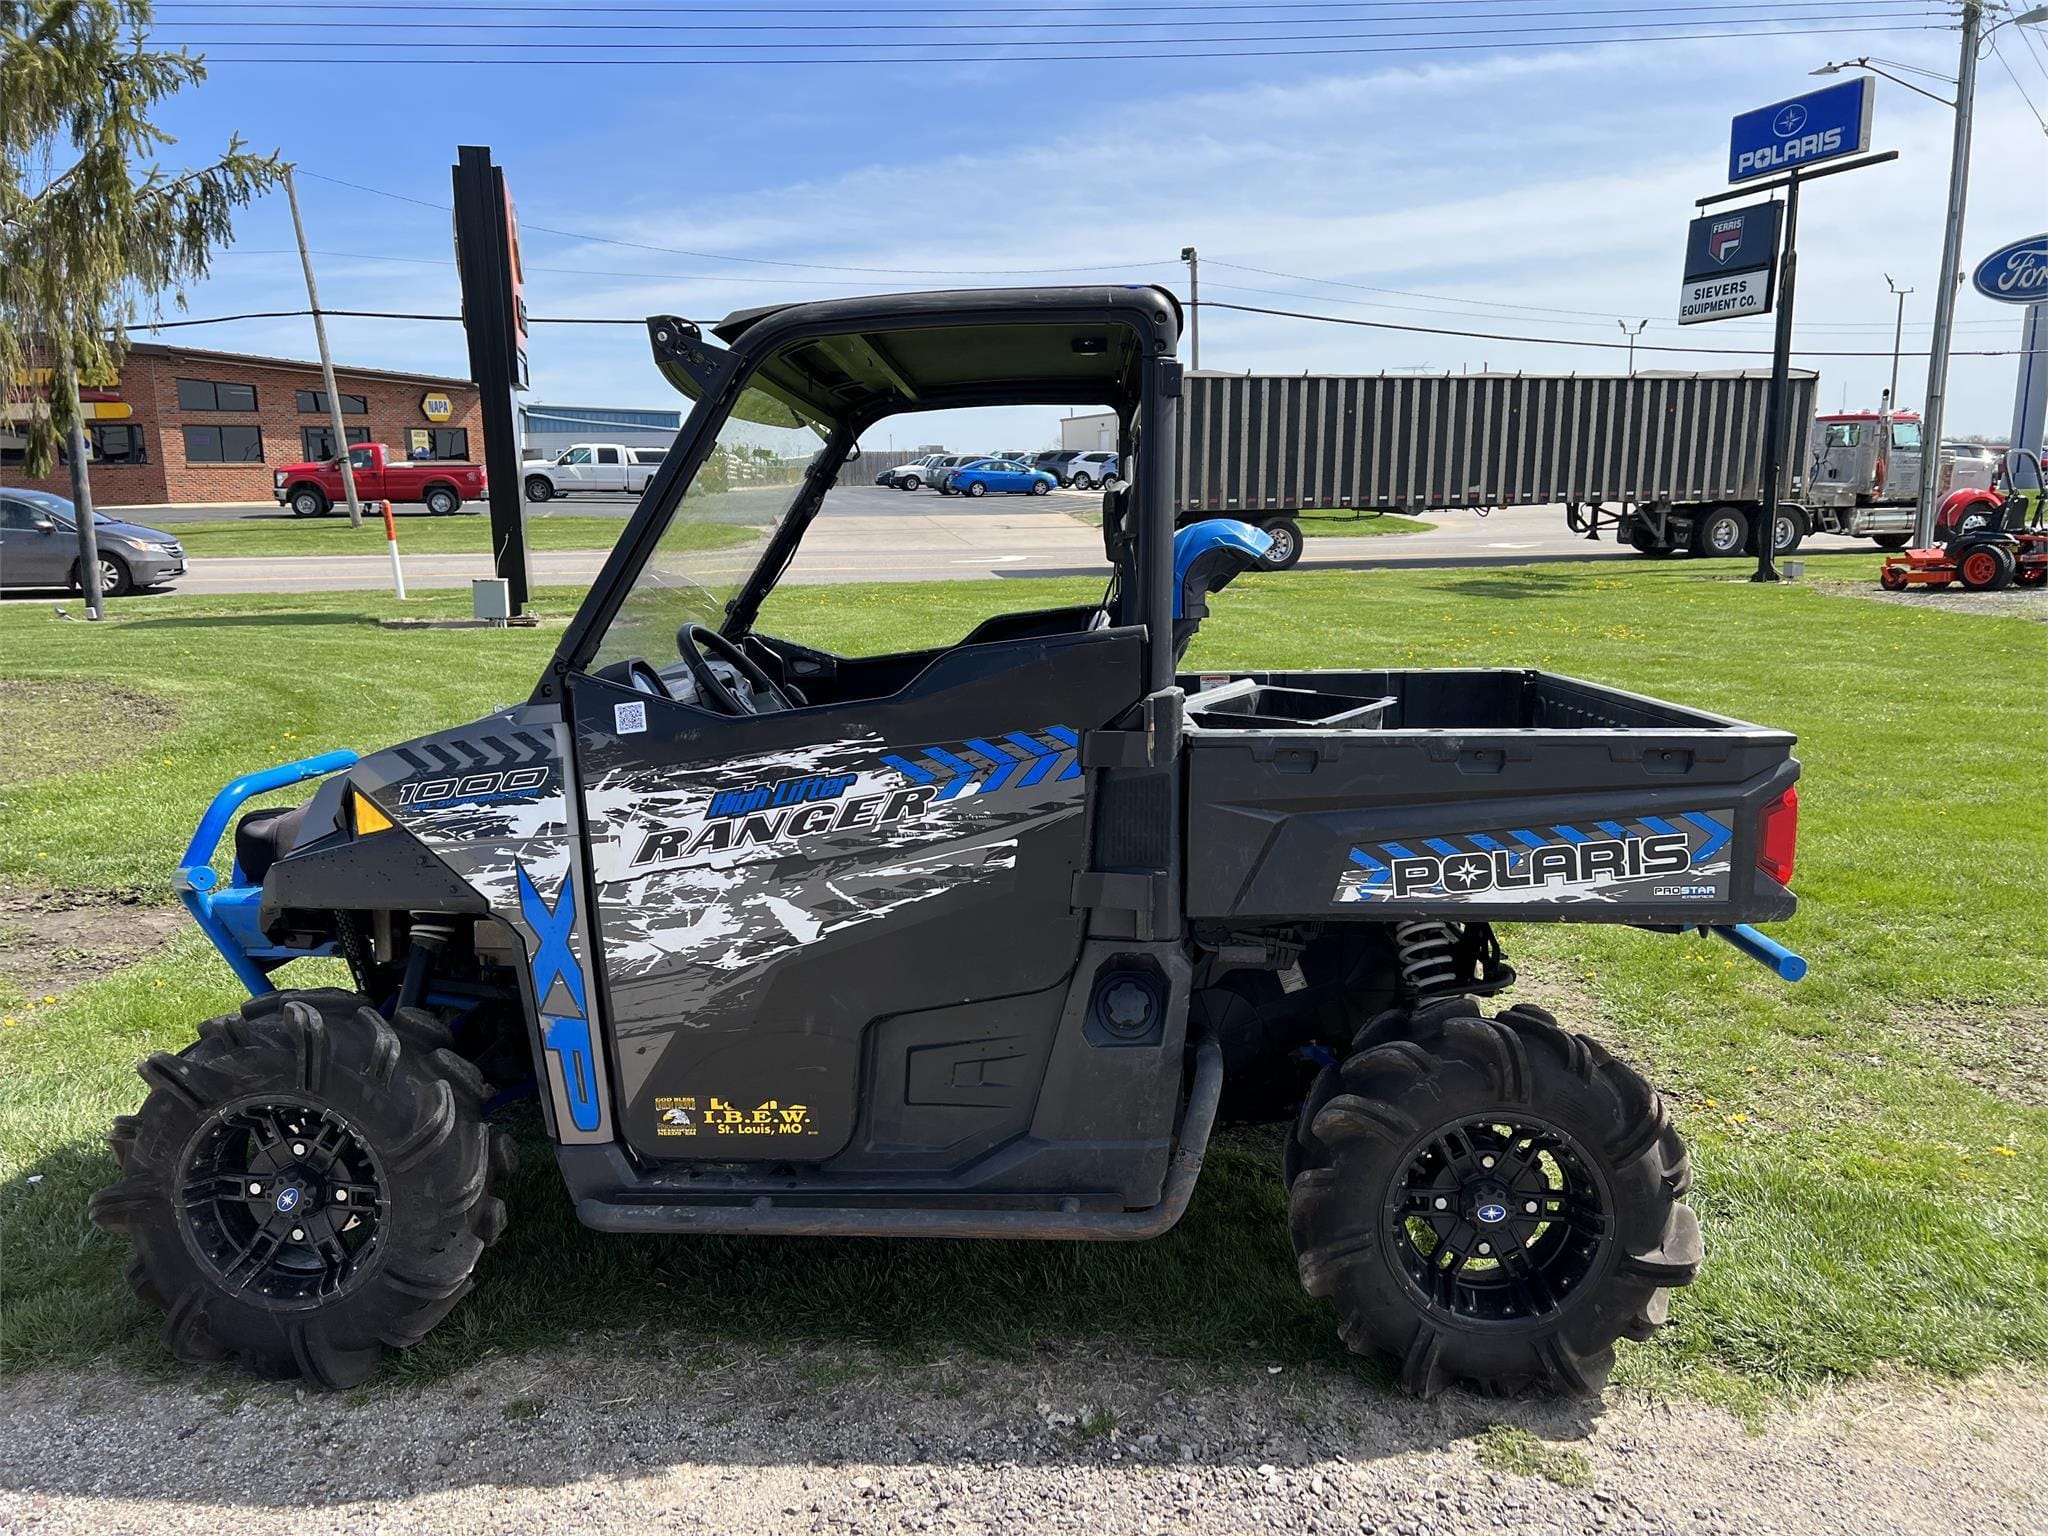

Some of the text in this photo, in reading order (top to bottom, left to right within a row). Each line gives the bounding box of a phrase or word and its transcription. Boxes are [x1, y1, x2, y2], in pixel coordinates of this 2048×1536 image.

[1738, 127, 1841, 173] POLARIS
[1713, 220, 1742, 233] FERRIS
[1998, 250, 2048, 290] For
[1694, 281, 1747, 300] SIEVERS
[1682, 295, 1757, 316] EQUIPMENT CO.
[428, 400, 449, 413] NAPA
[399, 766, 549, 805] 1000
[709, 773, 858, 818] High Lifter
[403, 802, 433, 812] DUAL
[630, 785, 938, 867] RANGER
[1391, 832, 1691, 899] POLARIS
[1654, 886, 1716, 896] PROSTAR
[703, 1110, 811, 1124] I.B.E.W.
[717, 1123, 802, 1136] St. Louis, MO
